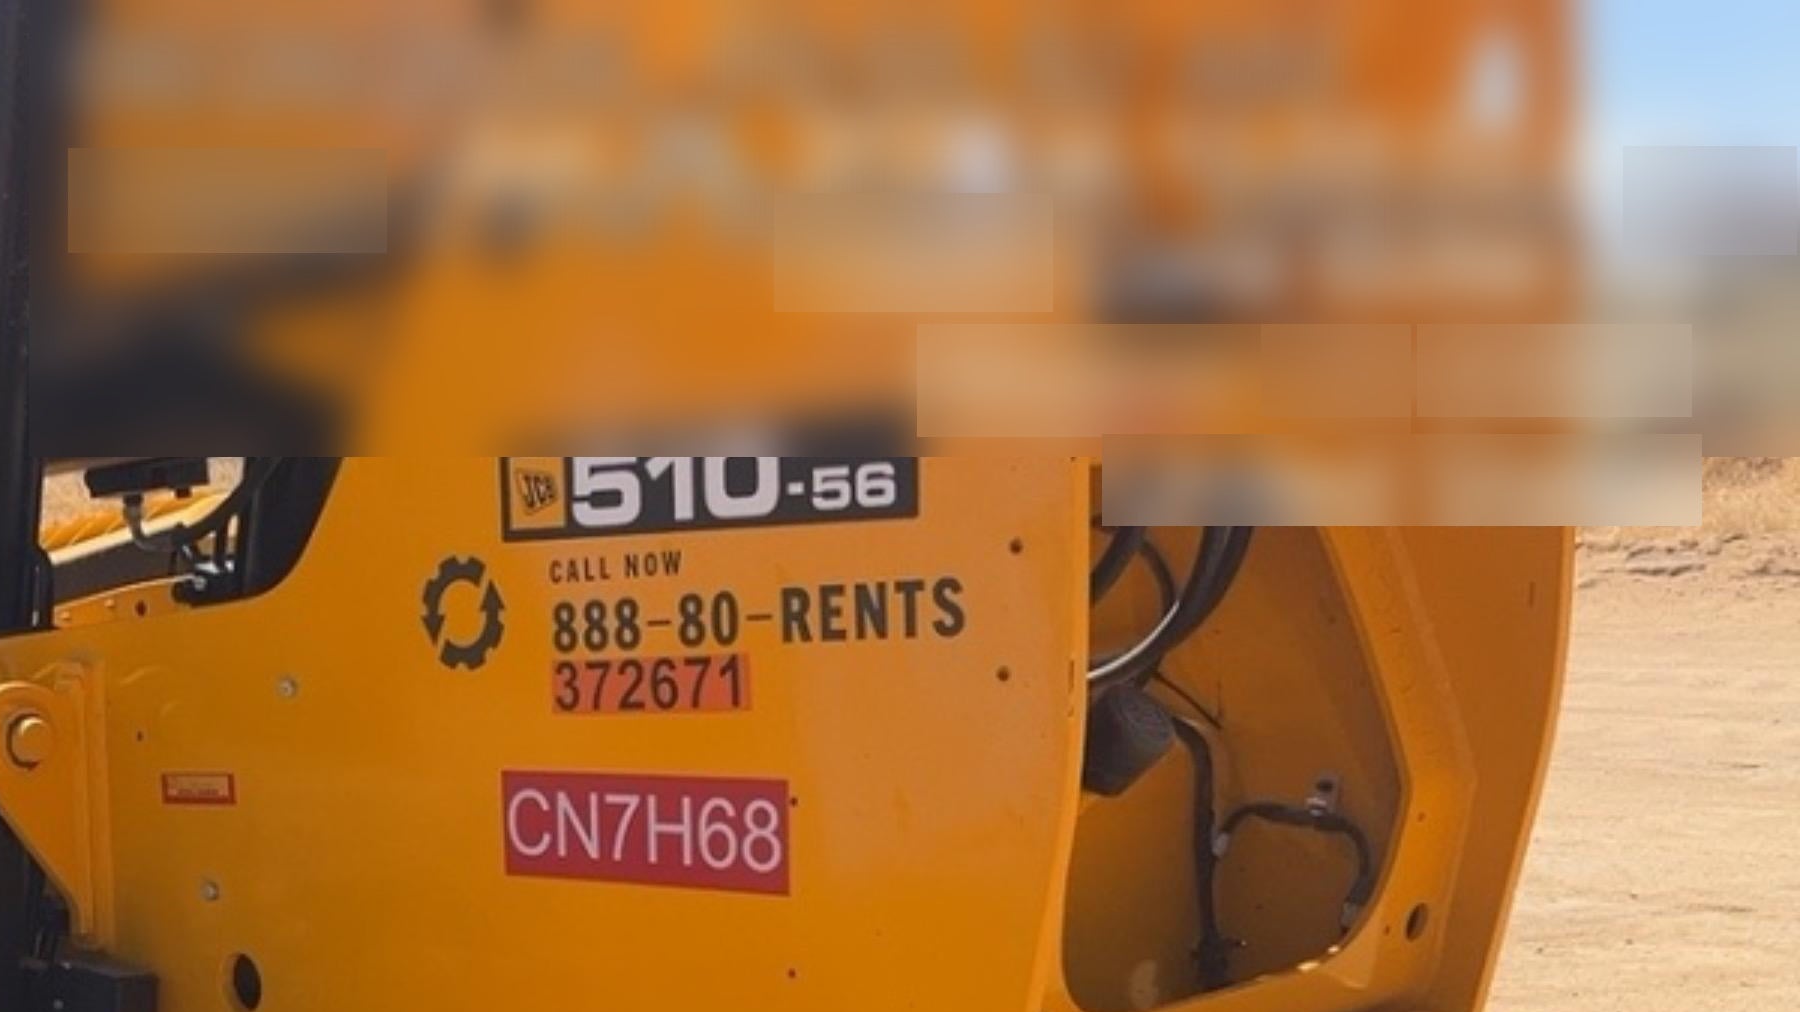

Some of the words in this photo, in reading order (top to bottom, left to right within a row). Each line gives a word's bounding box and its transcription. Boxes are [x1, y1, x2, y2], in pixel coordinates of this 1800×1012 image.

[519, 470, 556, 511] JCB
[549, 557, 610, 584] CALL
[624, 551, 682, 578] NOW
[553, 577, 965, 653] 888-80-RENTS
[555, 655, 743, 711] 372671
[507, 789, 781, 873] CN7H68
